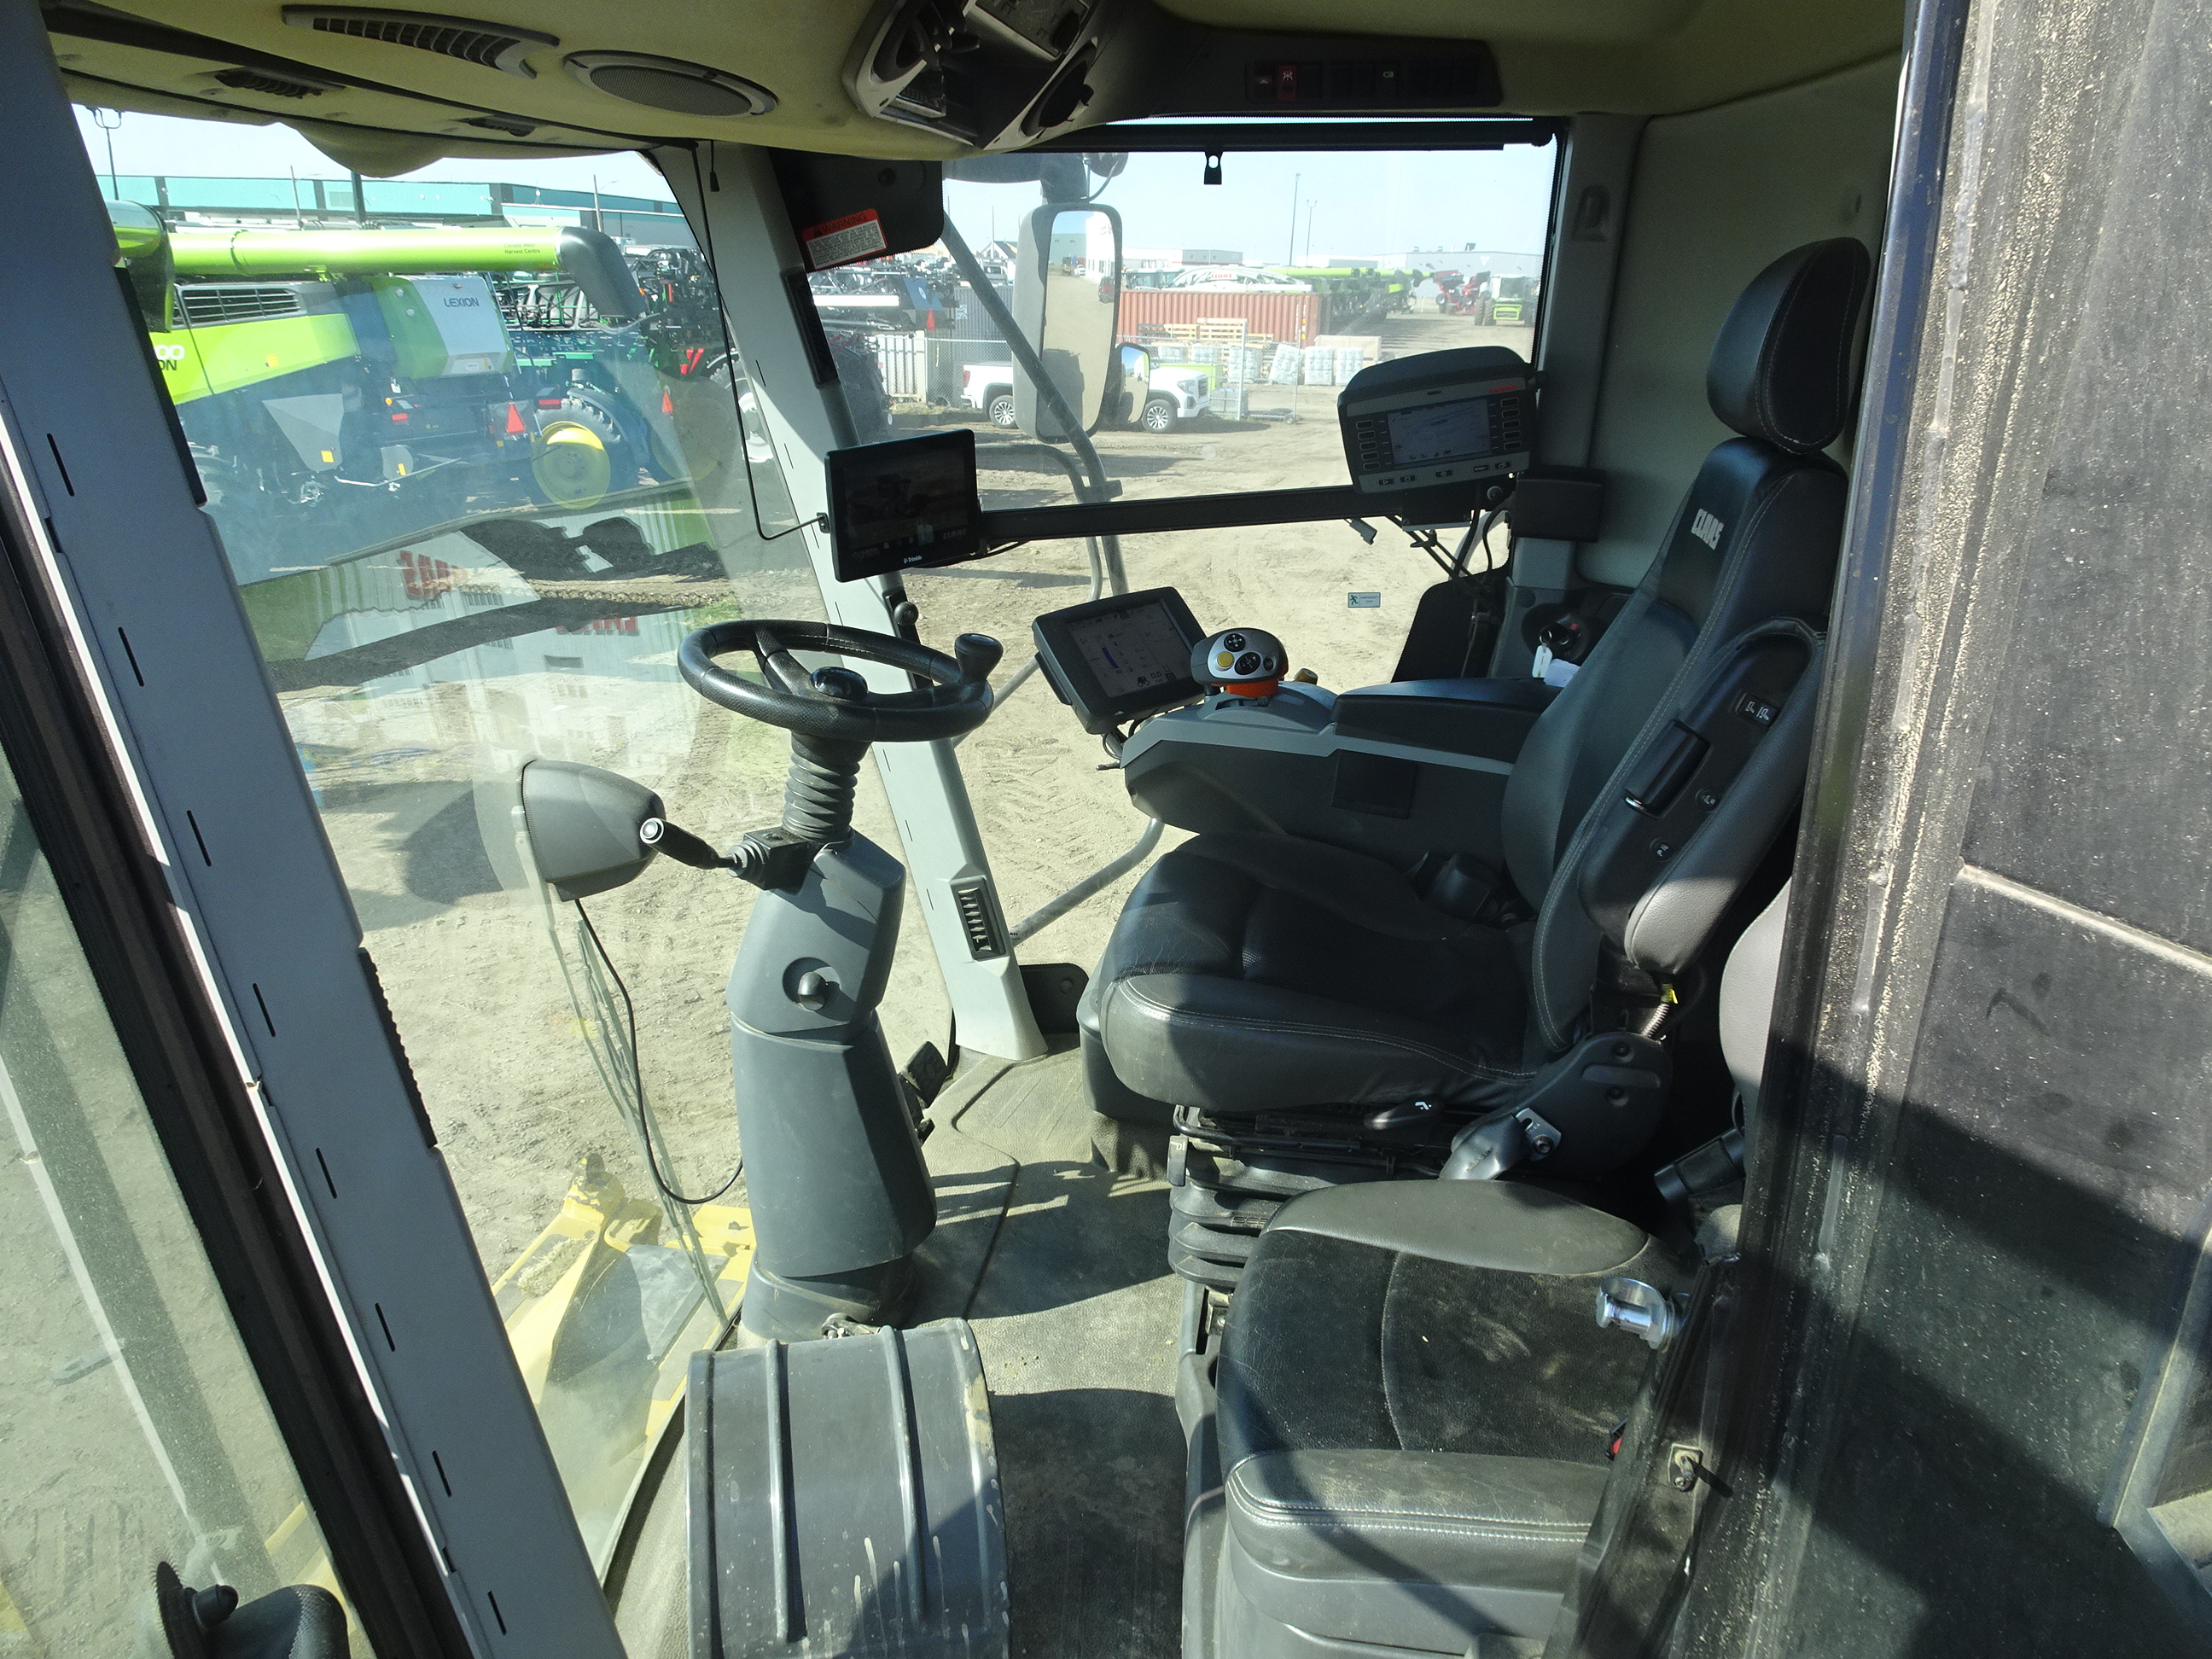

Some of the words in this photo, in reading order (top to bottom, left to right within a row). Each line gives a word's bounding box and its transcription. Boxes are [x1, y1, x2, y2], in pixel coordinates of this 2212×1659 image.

[823, 213, 867, 235] WARNING
[443, 297, 480, 308] LEXION
[1691, 508, 1724, 550] CLAAS
